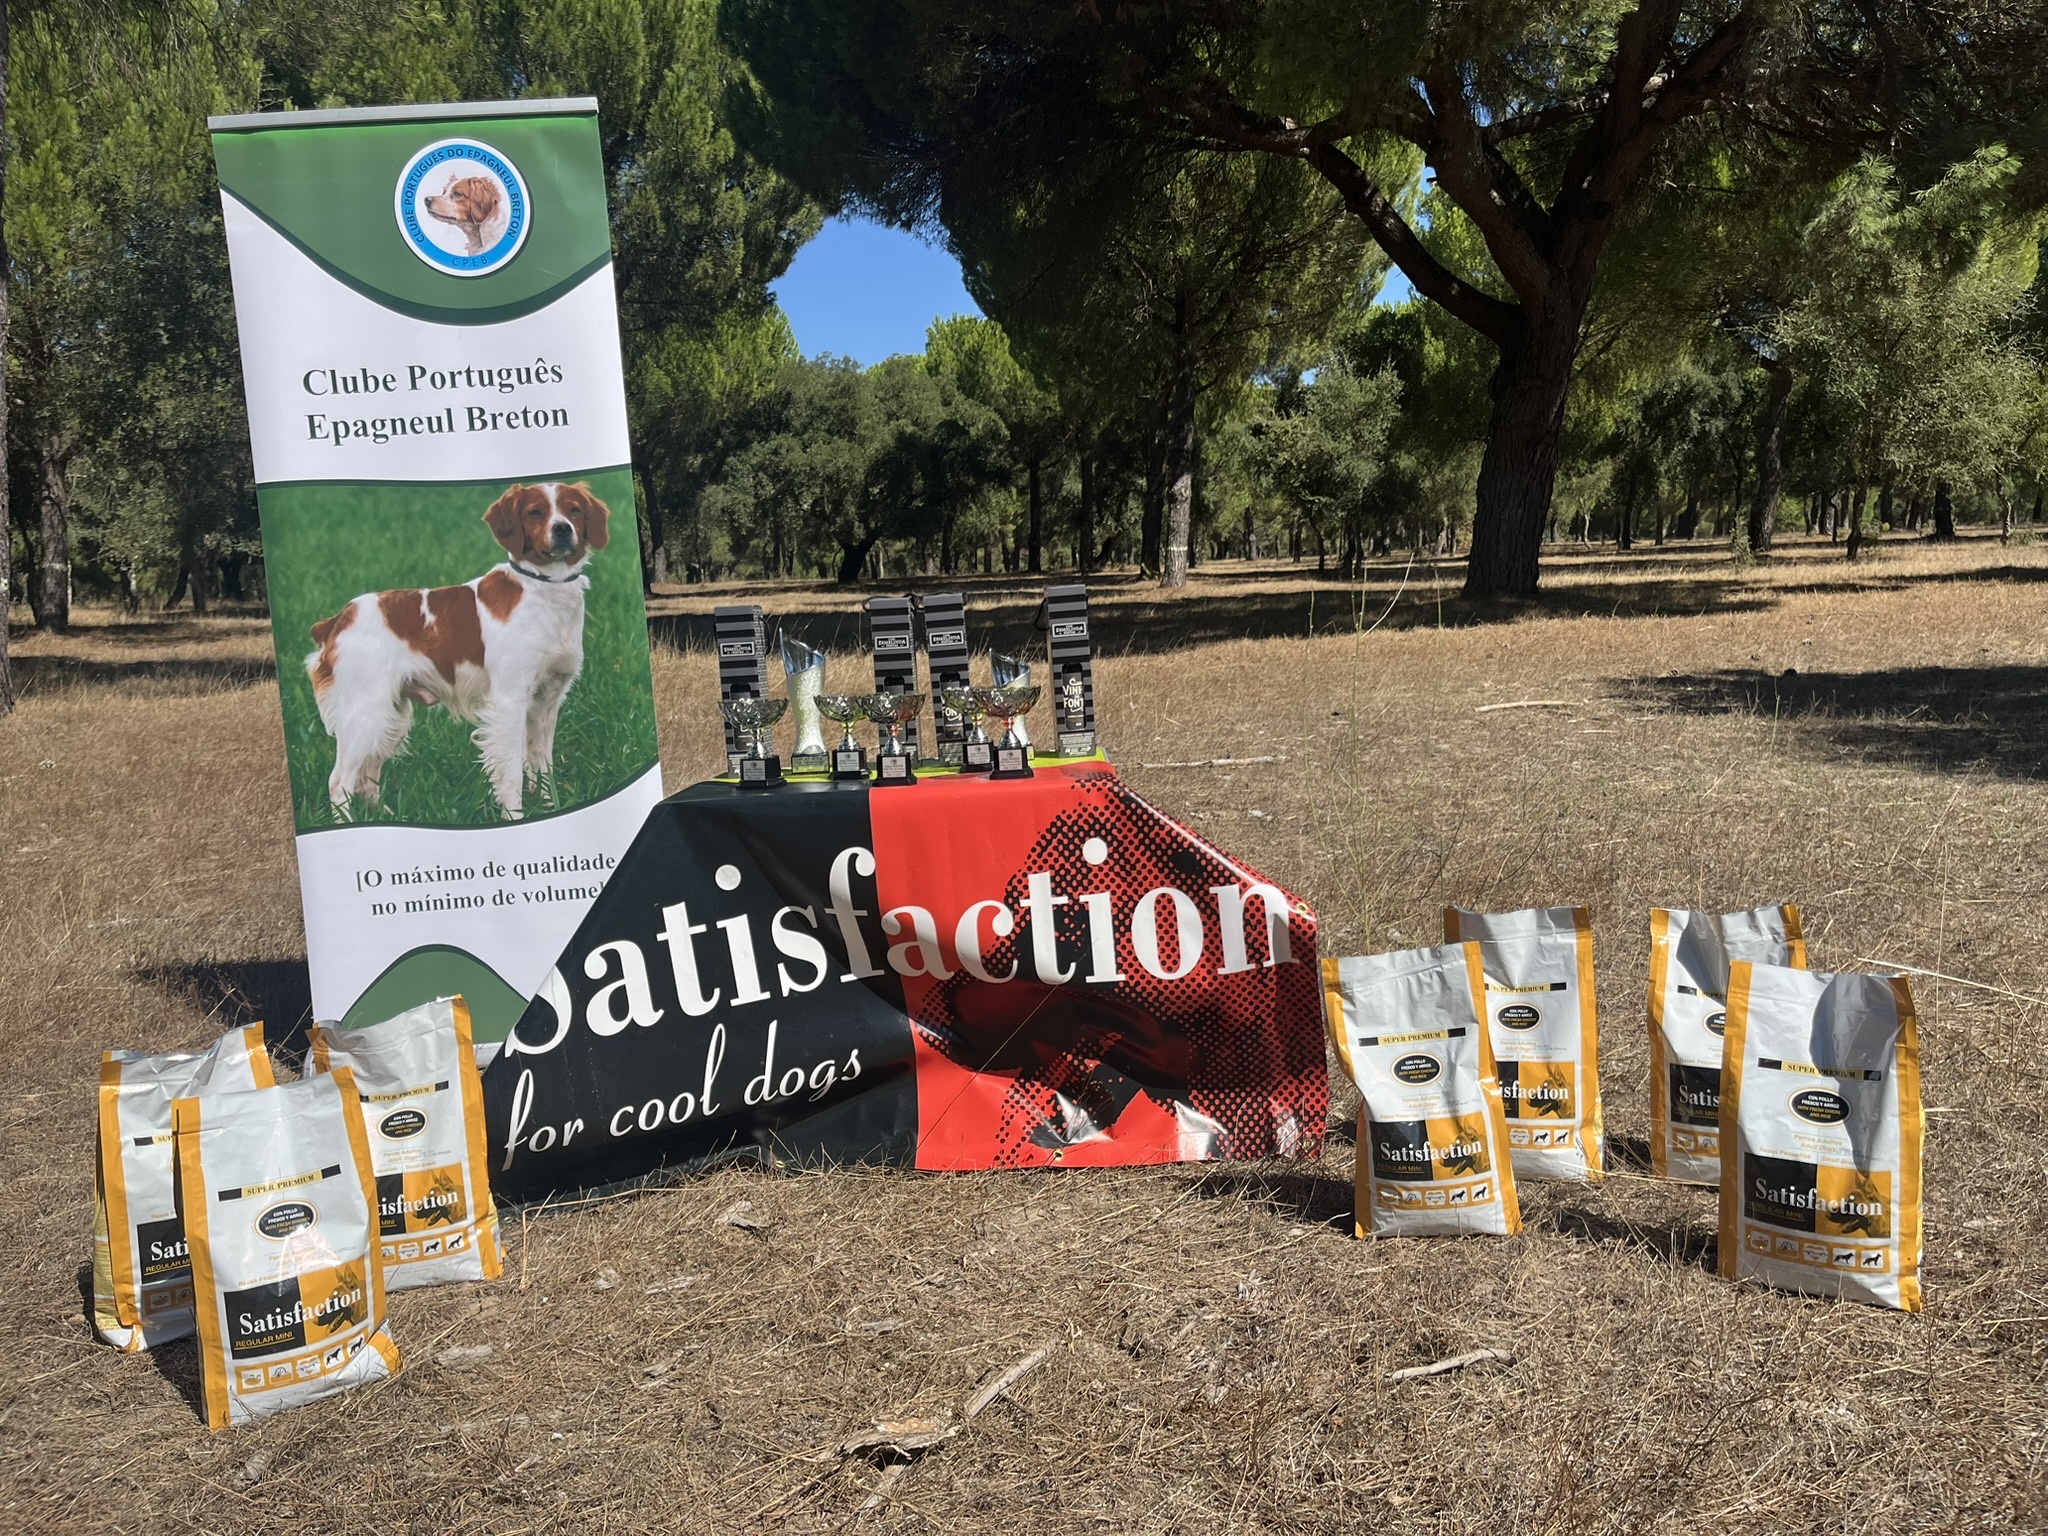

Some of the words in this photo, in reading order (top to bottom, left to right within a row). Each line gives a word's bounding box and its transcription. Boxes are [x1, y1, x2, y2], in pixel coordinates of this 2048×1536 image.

[447, 148, 464, 158] DO
[405, 151, 445, 205] PORTUGUÊS
[467, 149, 516, 191] EPAGNEUL
[405, 209, 425, 243] CLUBE
[507, 192, 521, 238] BRETON
[302, 368, 398, 396] Clube
[405, 357, 564, 394] Português
[304, 407, 455, 447] Epagneul
[464, 405, 570, 432] Breton
[390, 864, 475, 886] máximo
[482, 861, 506, 878] de
[513, 853, 616, 881] qualidade
[371, 901, 398, 917] no
[404, 893, 485, 914] mínimo
[492, 889, 516, 907] de
[1383, 1035, 1407, 1044] SUPER
[1408, 1031, 1441, 1042] PREMIUM
[1787, 1064, 1815, 1074] SUPER
[374, 1094, 397, 1102] SUPER
[502, 1071, 585, 1172] for
[609, 1023, 727, 1138] cool
[744, 1020, 865, 1108] dogs
[1499, 1080, 1569, 1100] isfaction
[158, 1135, 174, 1143] SUP
[1380, 1139, 1483, 1163] Satisfaction
[247, 1184, 275, 1196] SUPER
[277, 1175, 315, 1191] PREMIUM
[1755, 1177, 1883, 1216] Satisfaction
[378, 1190, 459, 1217] isfaction
[145, 1261, 181, 1273] REGULAR
[239, 1287, 362, 1336] Satisfaction
[235, 1335, 274, 1348] REGULAR
[275, 1331, 293, 1341] MINI
